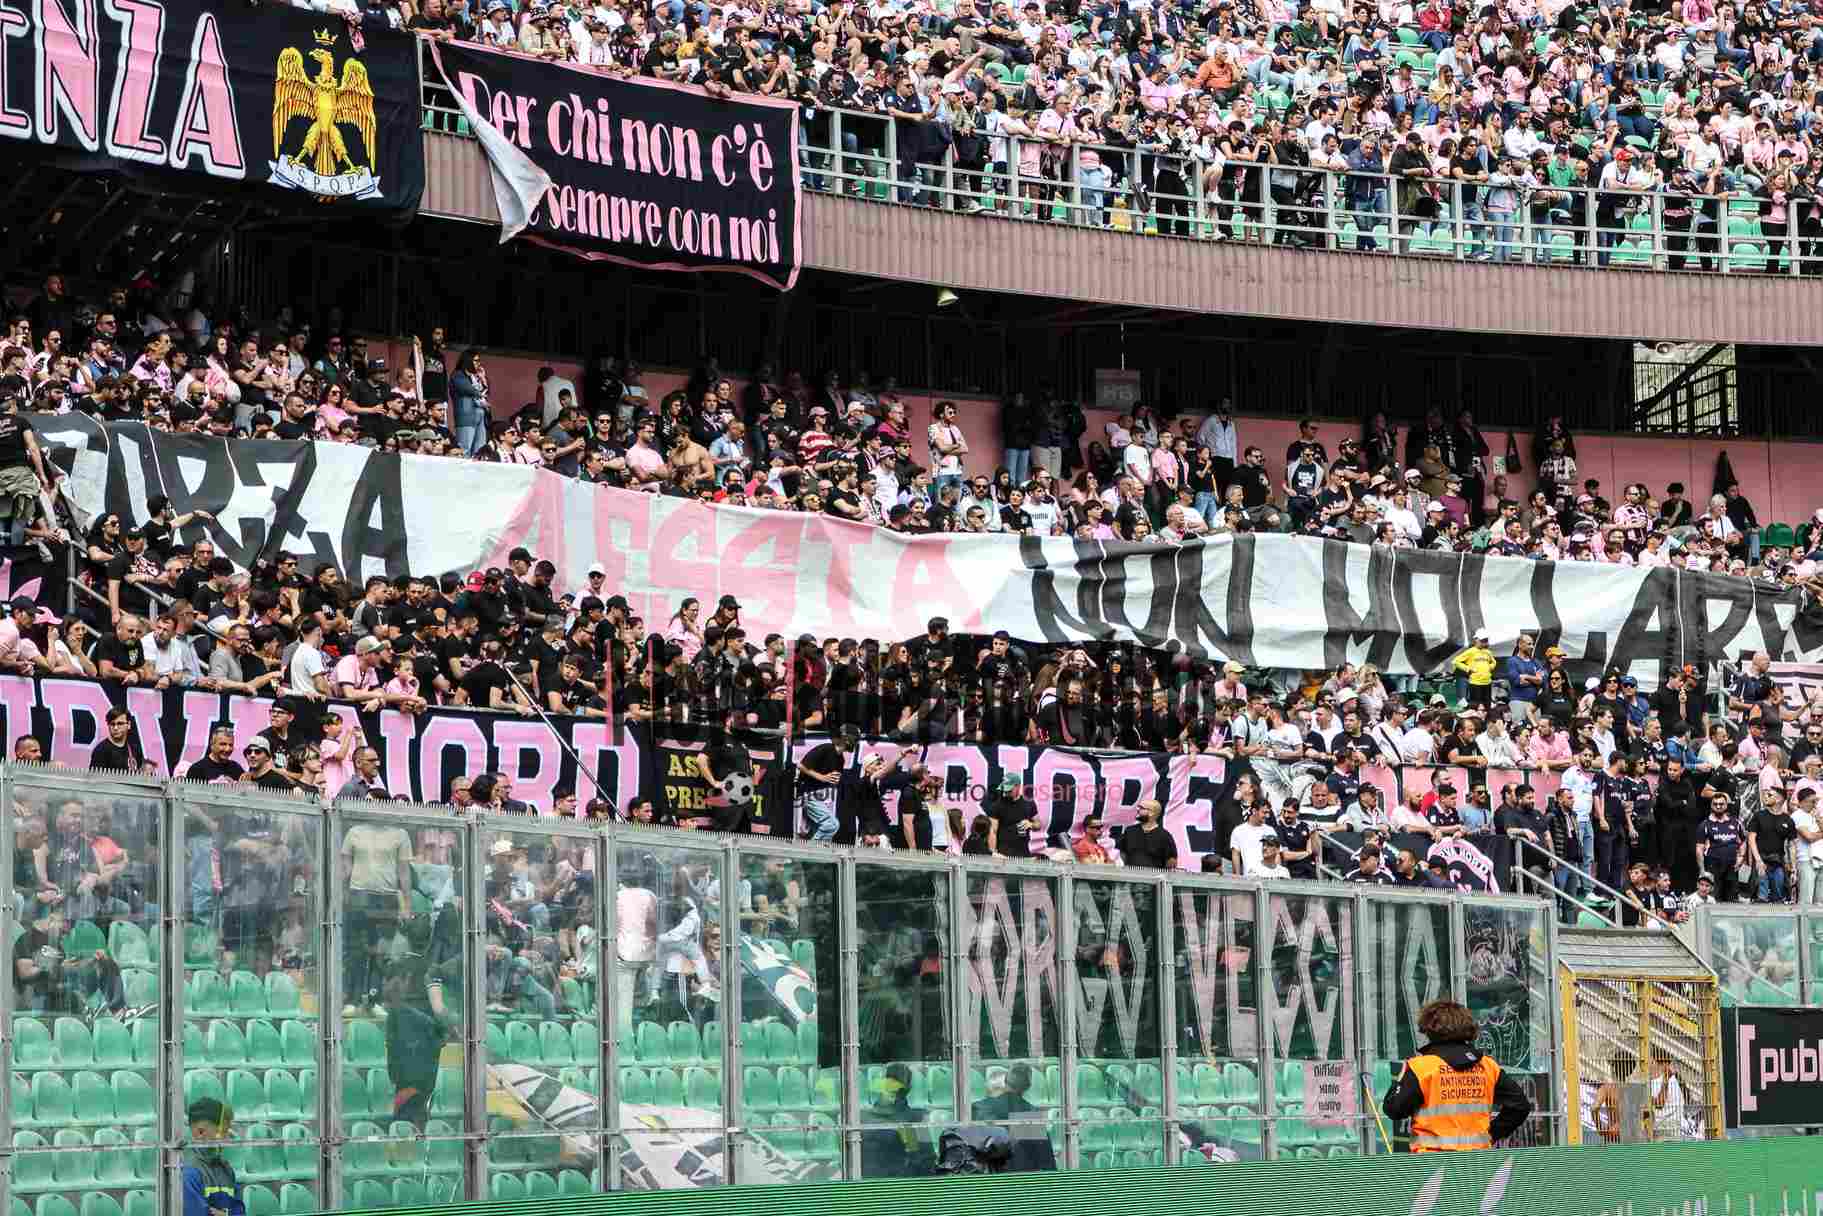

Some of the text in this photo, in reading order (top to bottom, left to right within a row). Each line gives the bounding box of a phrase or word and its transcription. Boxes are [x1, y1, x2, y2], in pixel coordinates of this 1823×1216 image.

[458, 71, 774, 192] Per chi non c'è
[546, 182, 781, 264] sempre con noi
[1016, 533, 1256, 668] NON
[1322, 538, 1823, 688] MOLLAR
[326, 700, 640, 818] NORD
